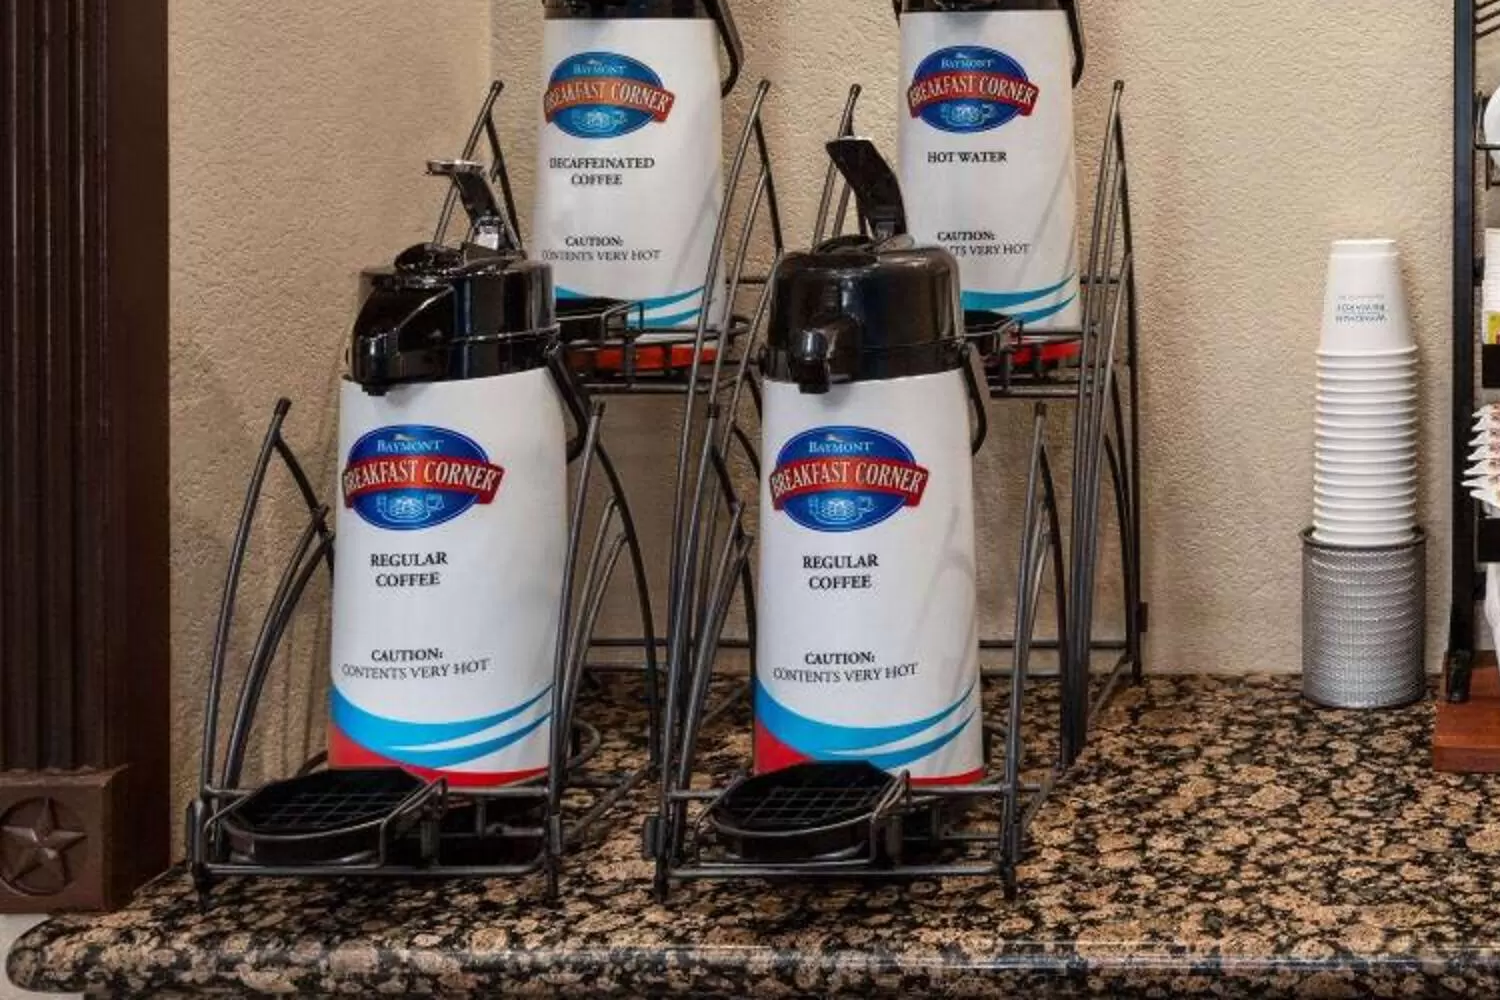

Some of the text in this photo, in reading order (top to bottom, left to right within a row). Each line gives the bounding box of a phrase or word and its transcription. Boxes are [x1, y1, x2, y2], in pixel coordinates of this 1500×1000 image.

[979, 75, 1035, 105] CORNER
[611, 83, 670, 113] CORNER
[549, 157, 655, 169] DECAFFEINATED
[927, 151, 1007, 163] HOT WATER
[571, 173, 623, 185] COFFEE
[564, 235, 624, 247] CAUTION:
[937, 231, 995, 242] CAUTION:
[596, 250, 629, 261] VERY
[631, 249, 661, 260] HOT
[969, 244, 1000, 256] VERY
[1003, 243, 1029, 255] HOT
[376, 439, 440, 451] BAYMONT
[808, 441, 870, 452] BAYMONT
[423, 461, 497, 491] CORNER
[771, 461, 922, 497] BREAKFAST CORNER
[370, 551, 449, 567] REGULAR
[802, 553, 880, 569] REGULAR
[375, 572, 441, 587] COFFEE
[808, 574, 872, 590] COFFEE
[371, 648, 443, 662] CAUTION:
[804, 651, 876, 665] CAUTION:
[341, 657, 491, 680] CONTENTS VERY HOT
[773, 662, 919, 683] CONTENTS VERY HOT
